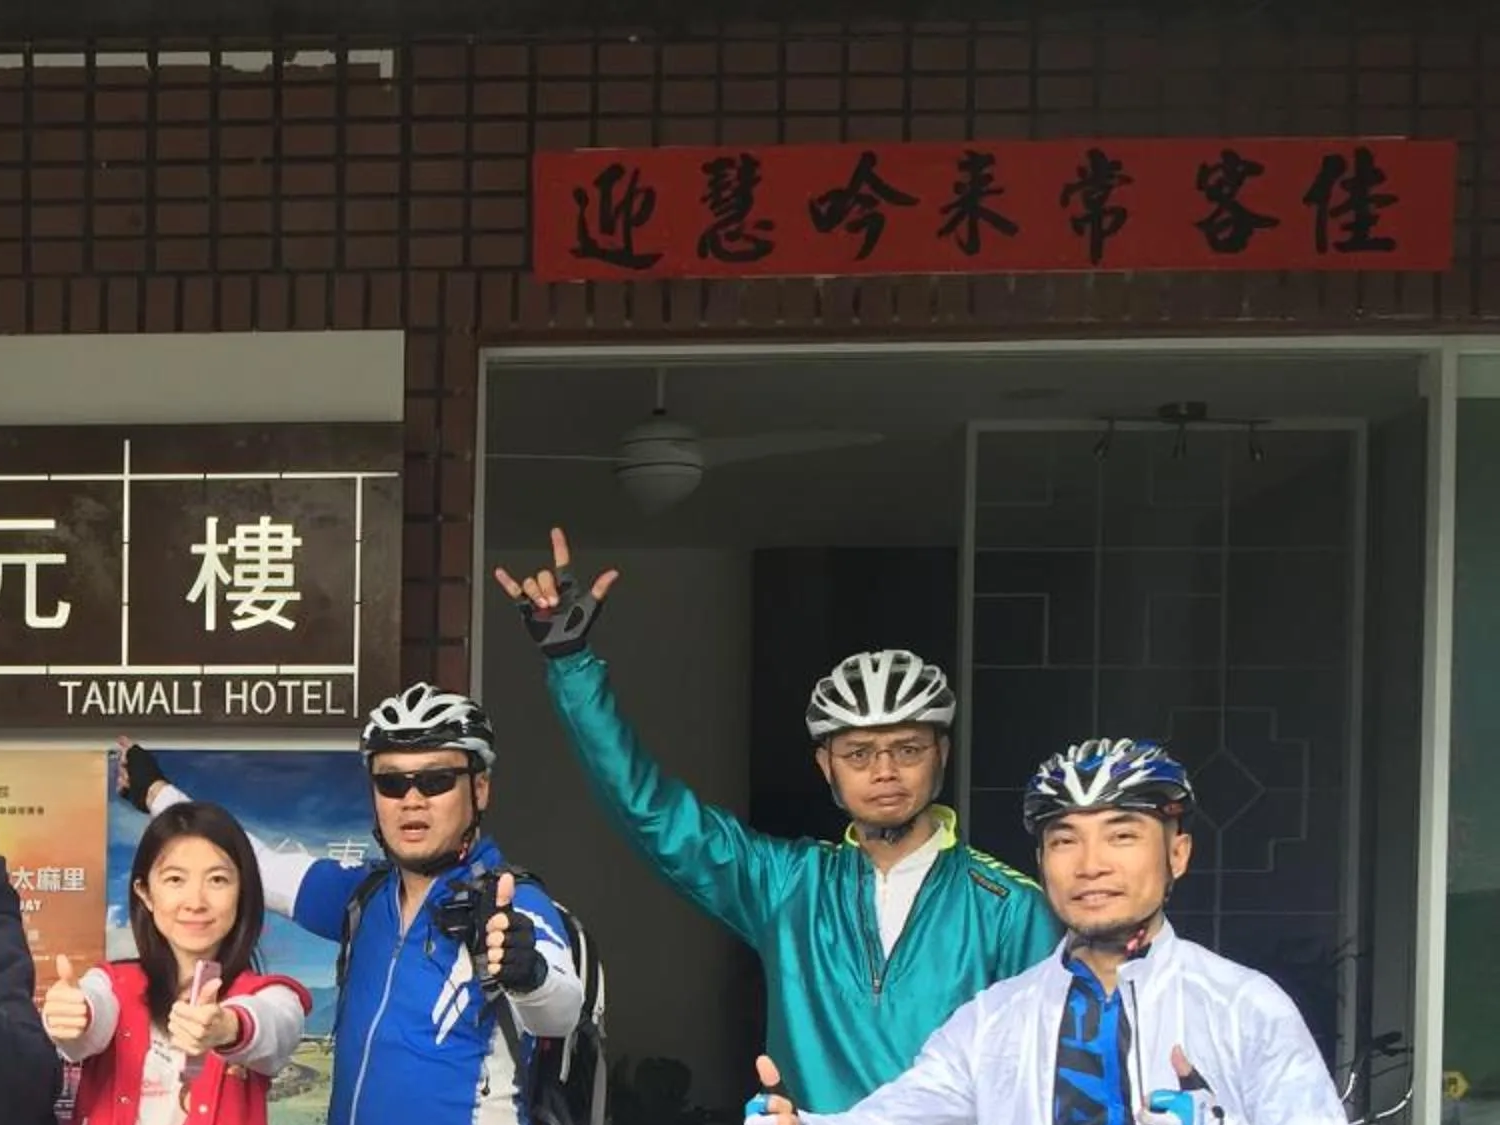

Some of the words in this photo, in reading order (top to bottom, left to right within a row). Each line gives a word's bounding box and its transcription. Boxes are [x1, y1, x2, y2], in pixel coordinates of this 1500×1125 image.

[59, 680, 204, 716] TAIMALI
[224, 680, 347, 716] HOTEL
[11, 866, 87, 893] 太麻里
